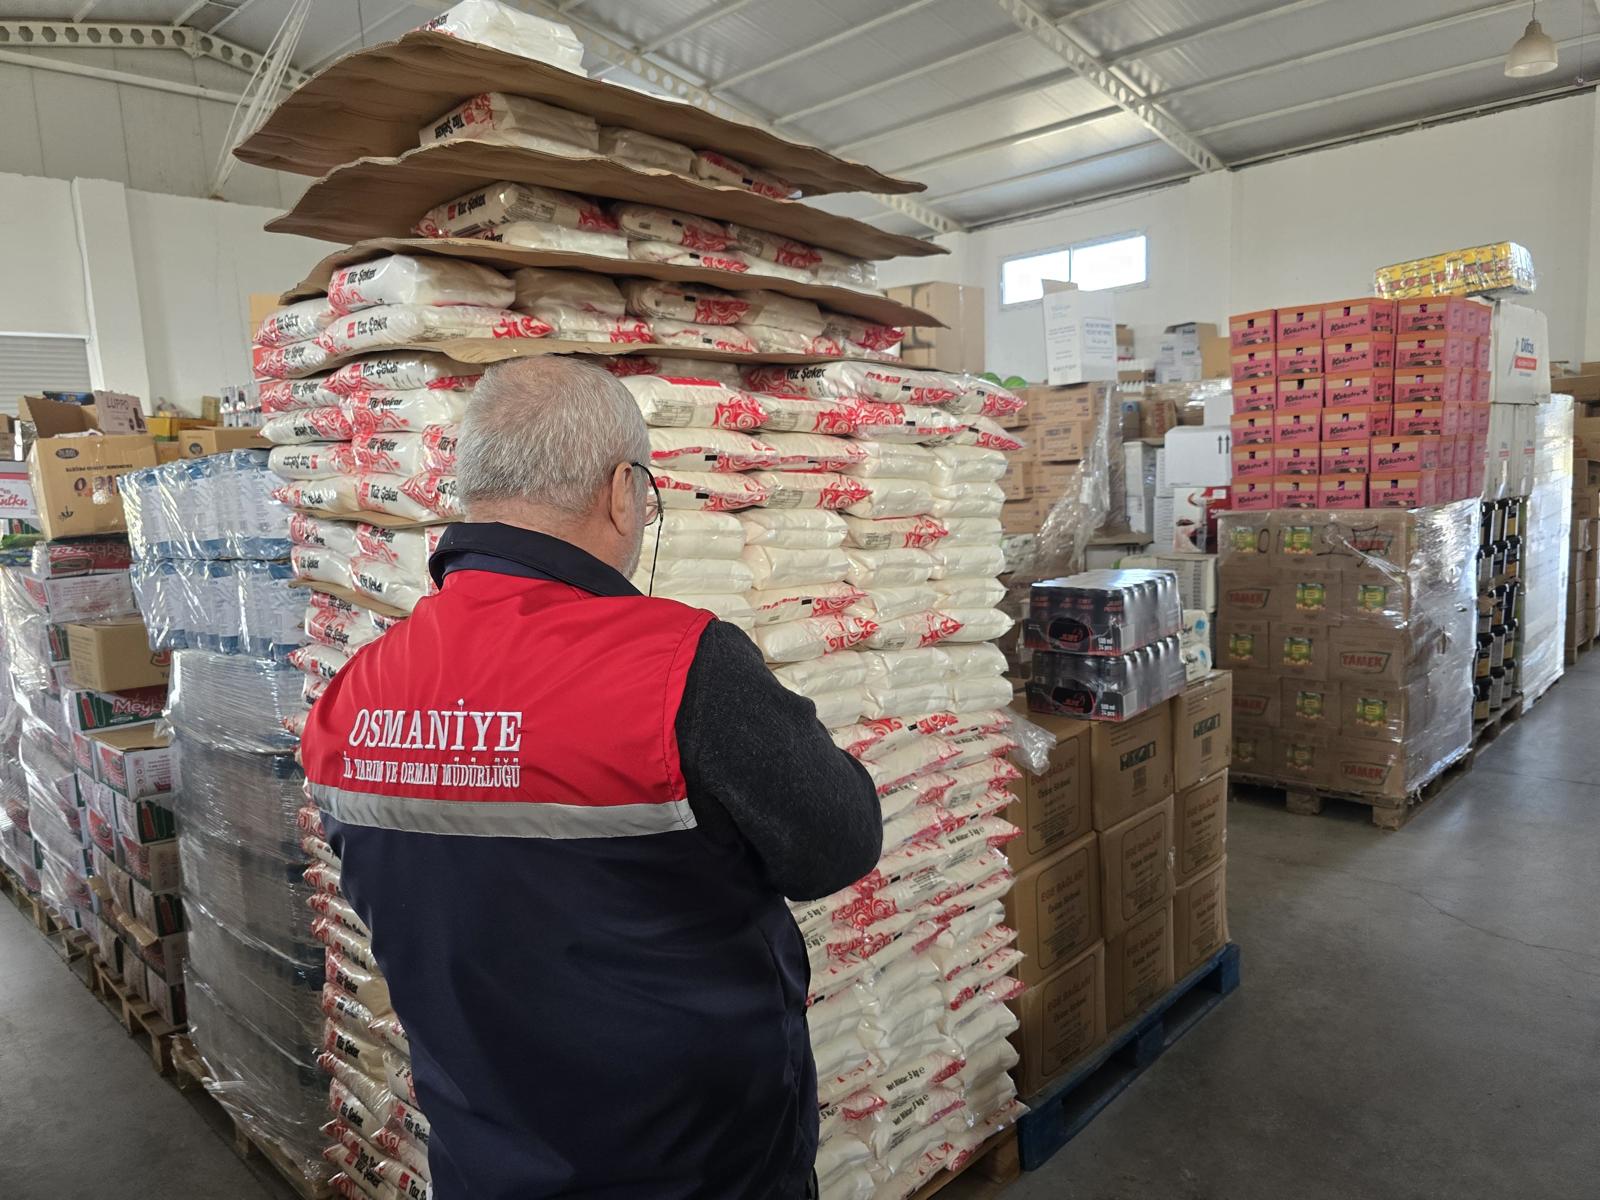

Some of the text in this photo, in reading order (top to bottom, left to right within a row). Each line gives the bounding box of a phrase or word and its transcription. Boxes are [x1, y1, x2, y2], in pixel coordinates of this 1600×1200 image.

[0, 494, 28, 506] utku
[1342, 654, 1382, 669] TAMEK
[349, 698, 522, 752] OSMANİYE
[343, 751, 521, 788] İL TARIM VE ORMAN MÜDÜRLÜĞÜ
[1342, 764, 1383, 780] TAMEK
